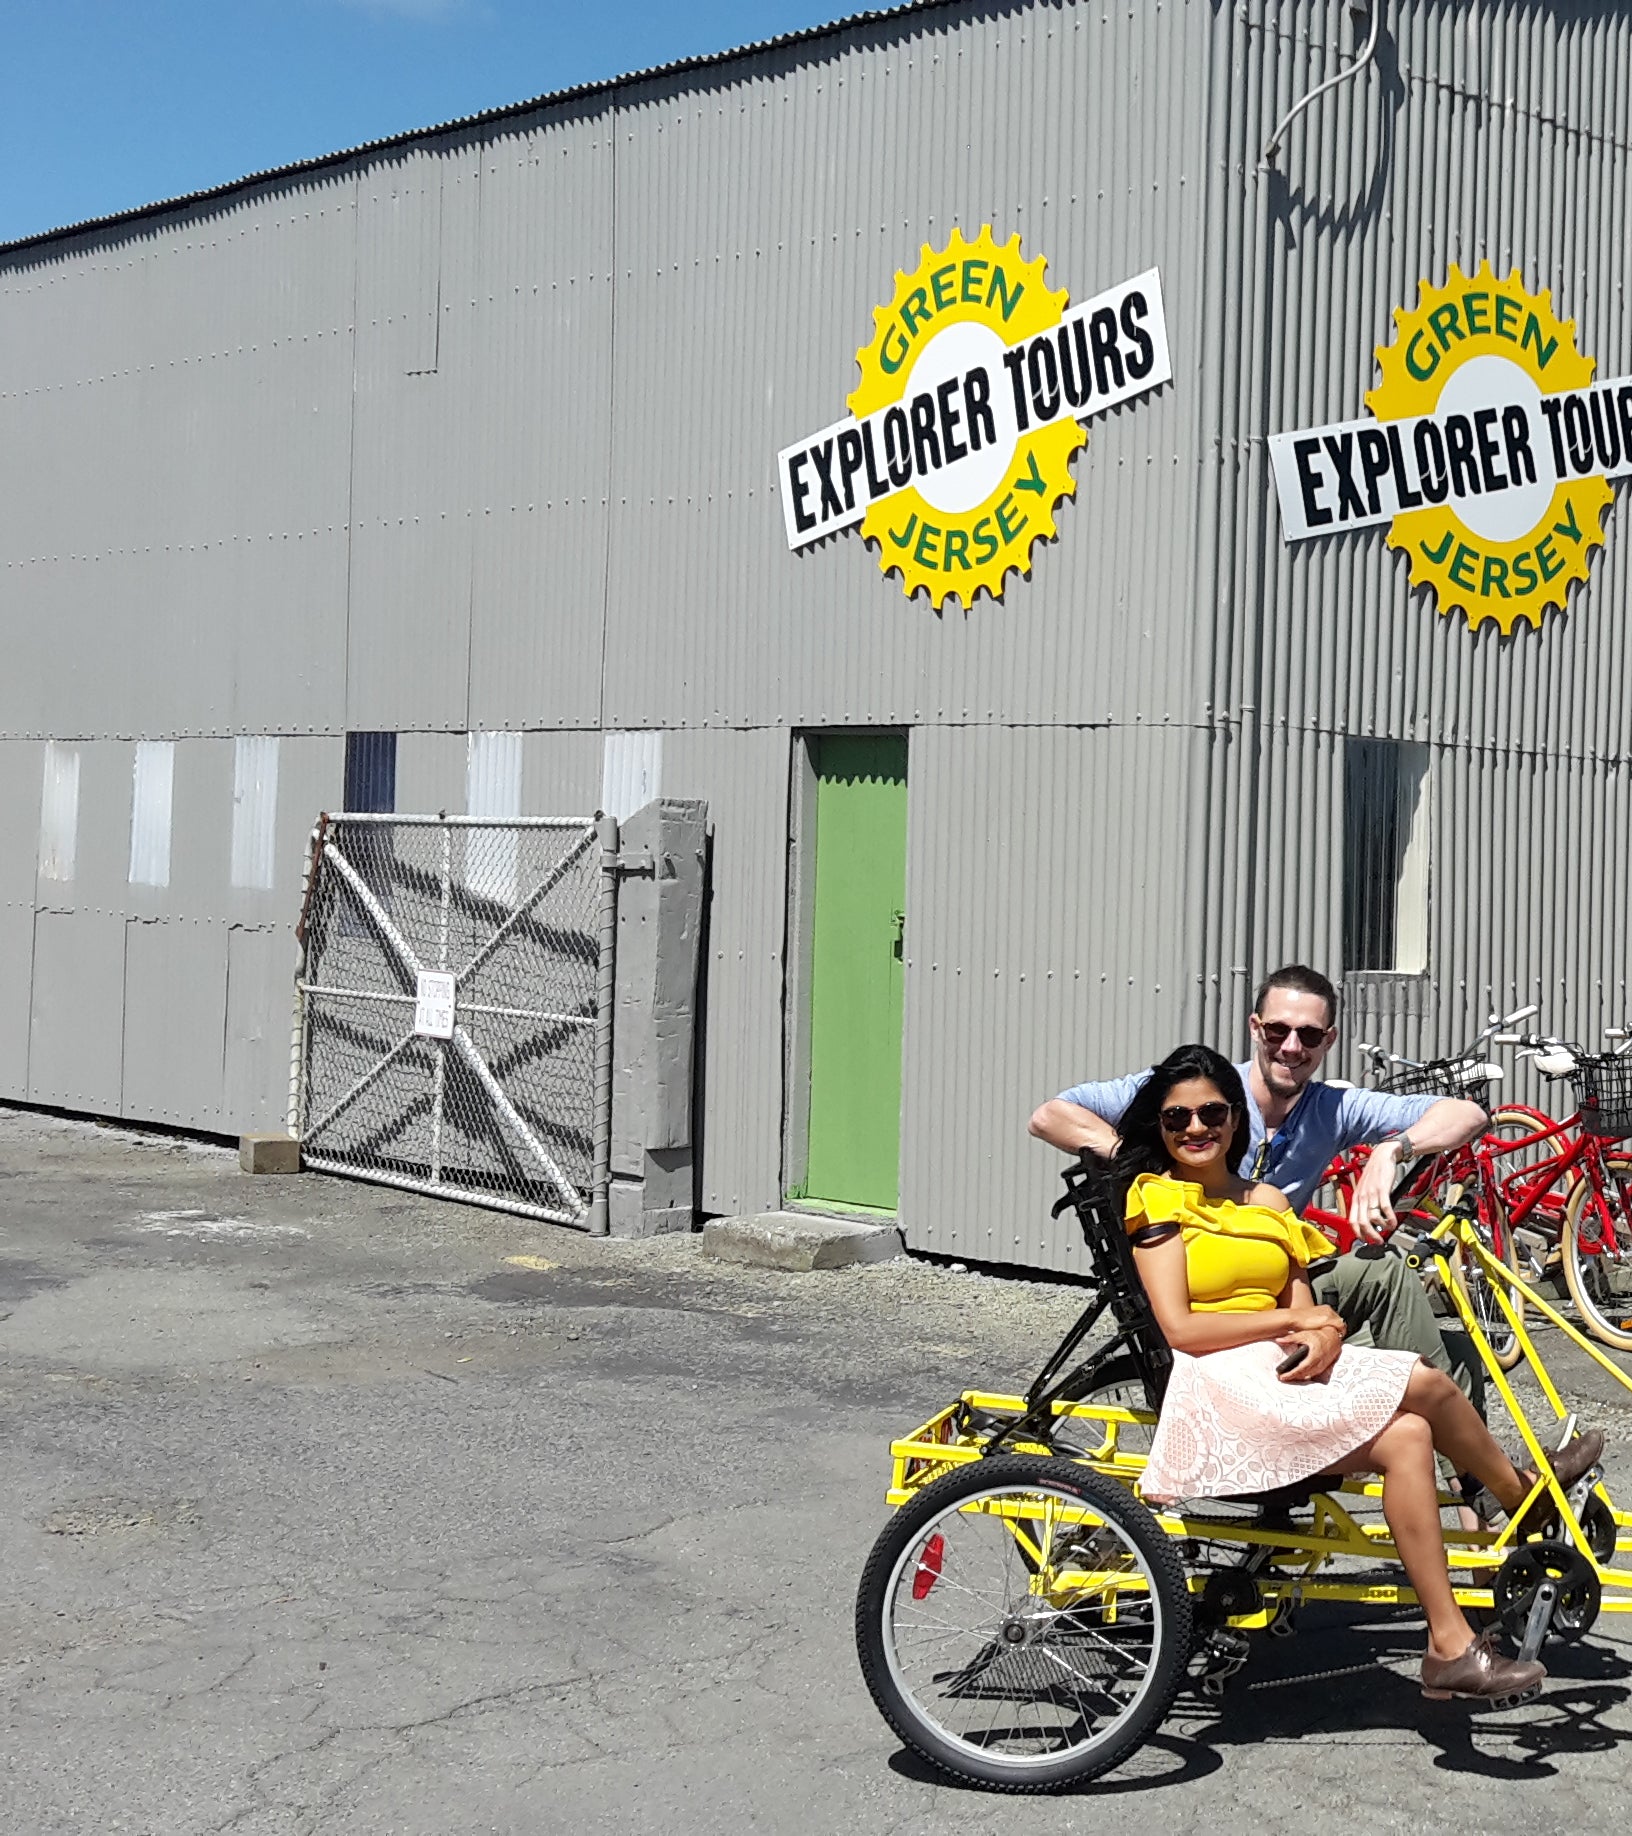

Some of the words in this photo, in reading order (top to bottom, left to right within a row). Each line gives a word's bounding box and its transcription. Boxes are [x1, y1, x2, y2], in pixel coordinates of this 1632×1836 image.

[880, 259, 1025, 375] GREEN
[1405, 291, 1559, 382] GREEN
[788, 366, 998, 534] EXPLORER
[1003, 290, 1155, 433] TOURS
[1293, 404, 1538, 528] EXPLORER
[888, 449, 1047, 572] JERSEY
[1419, 498, 1584, 599] JERSEY
